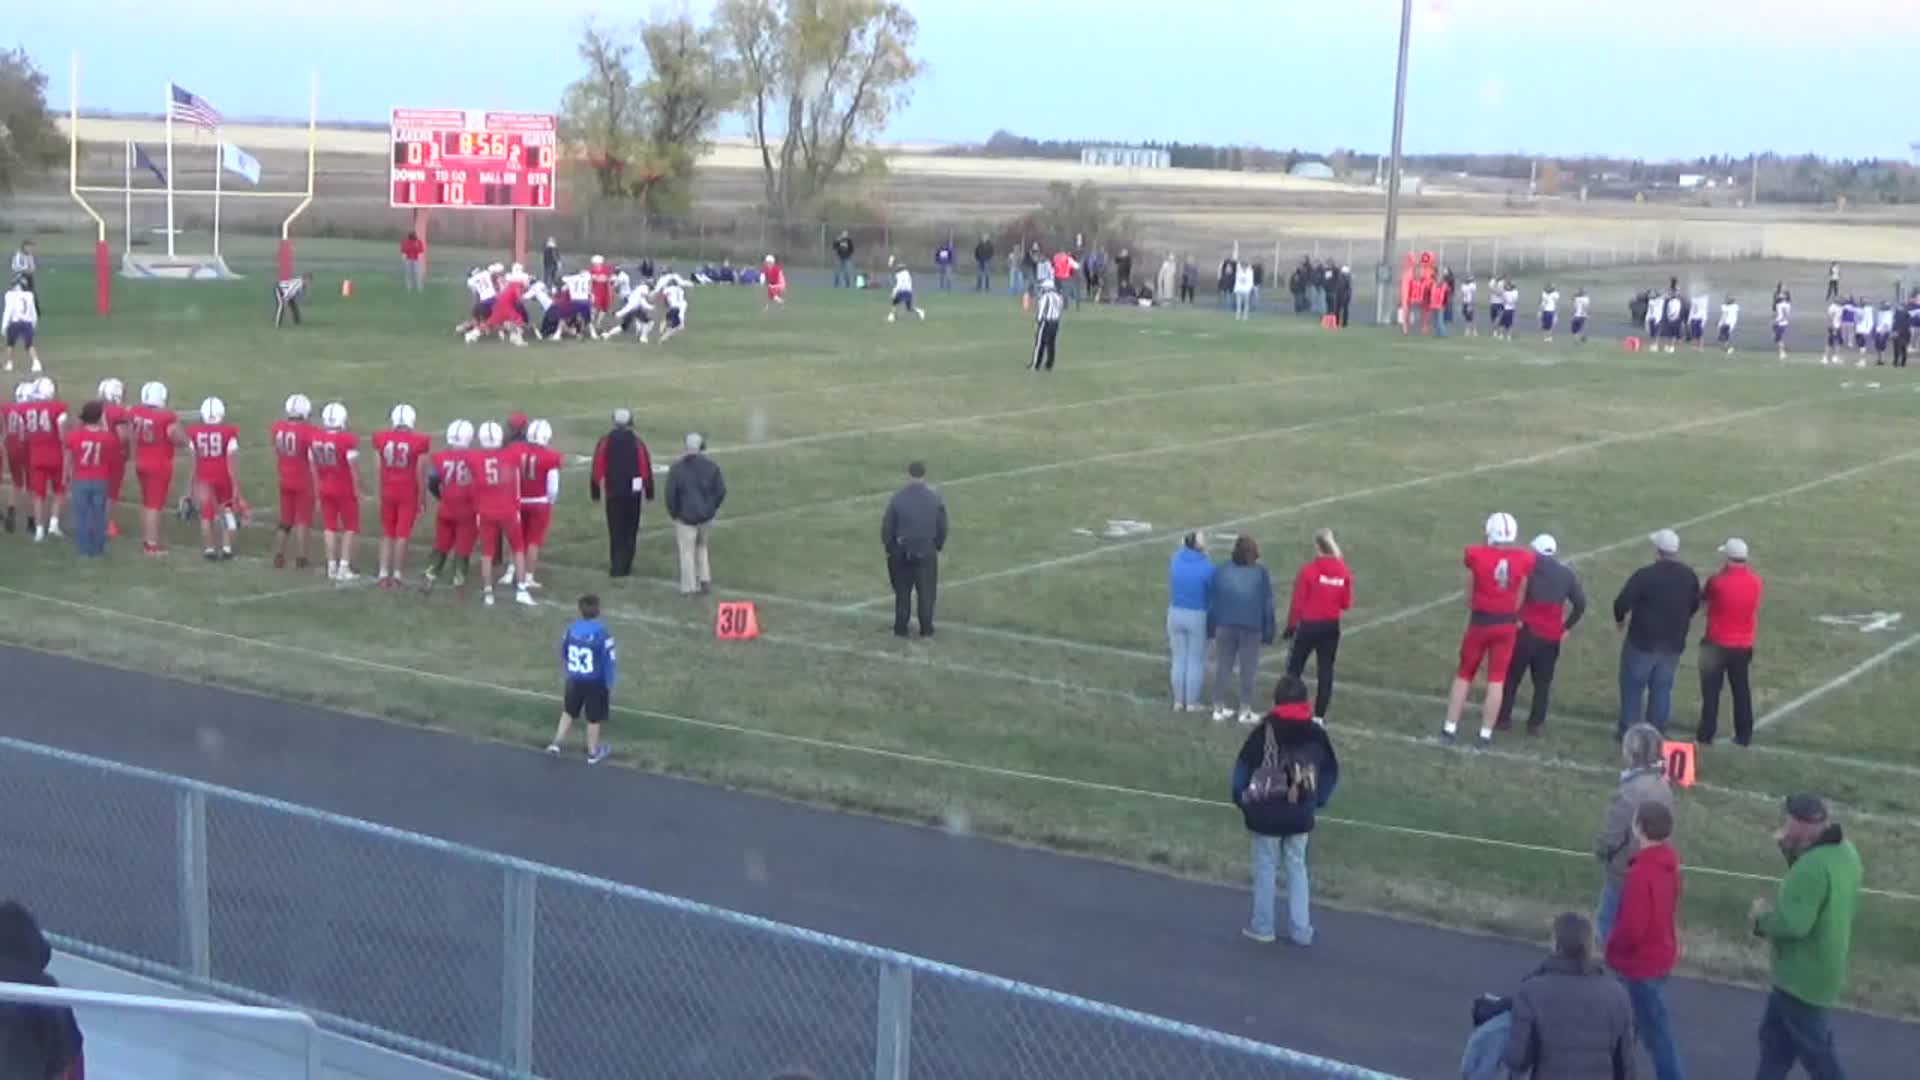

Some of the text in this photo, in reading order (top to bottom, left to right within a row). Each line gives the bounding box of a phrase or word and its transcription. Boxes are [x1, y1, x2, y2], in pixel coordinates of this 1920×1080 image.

[408, 142, 422, 164] 0
[539, 146, 553, 168] 0
[393, 169, 425, 182] DOWN
[26, 408, 50, 434] 84
[80, 440, 101, 465] 71
[196, 432, 222, 456] 59
[382, 440, 409, 469] 43
[484, 457, 499, 485] 5
[1493, 557, 1511, 590] 4
[720, 607, 748, 634] 30
[566, 644, 594, 674] 93
